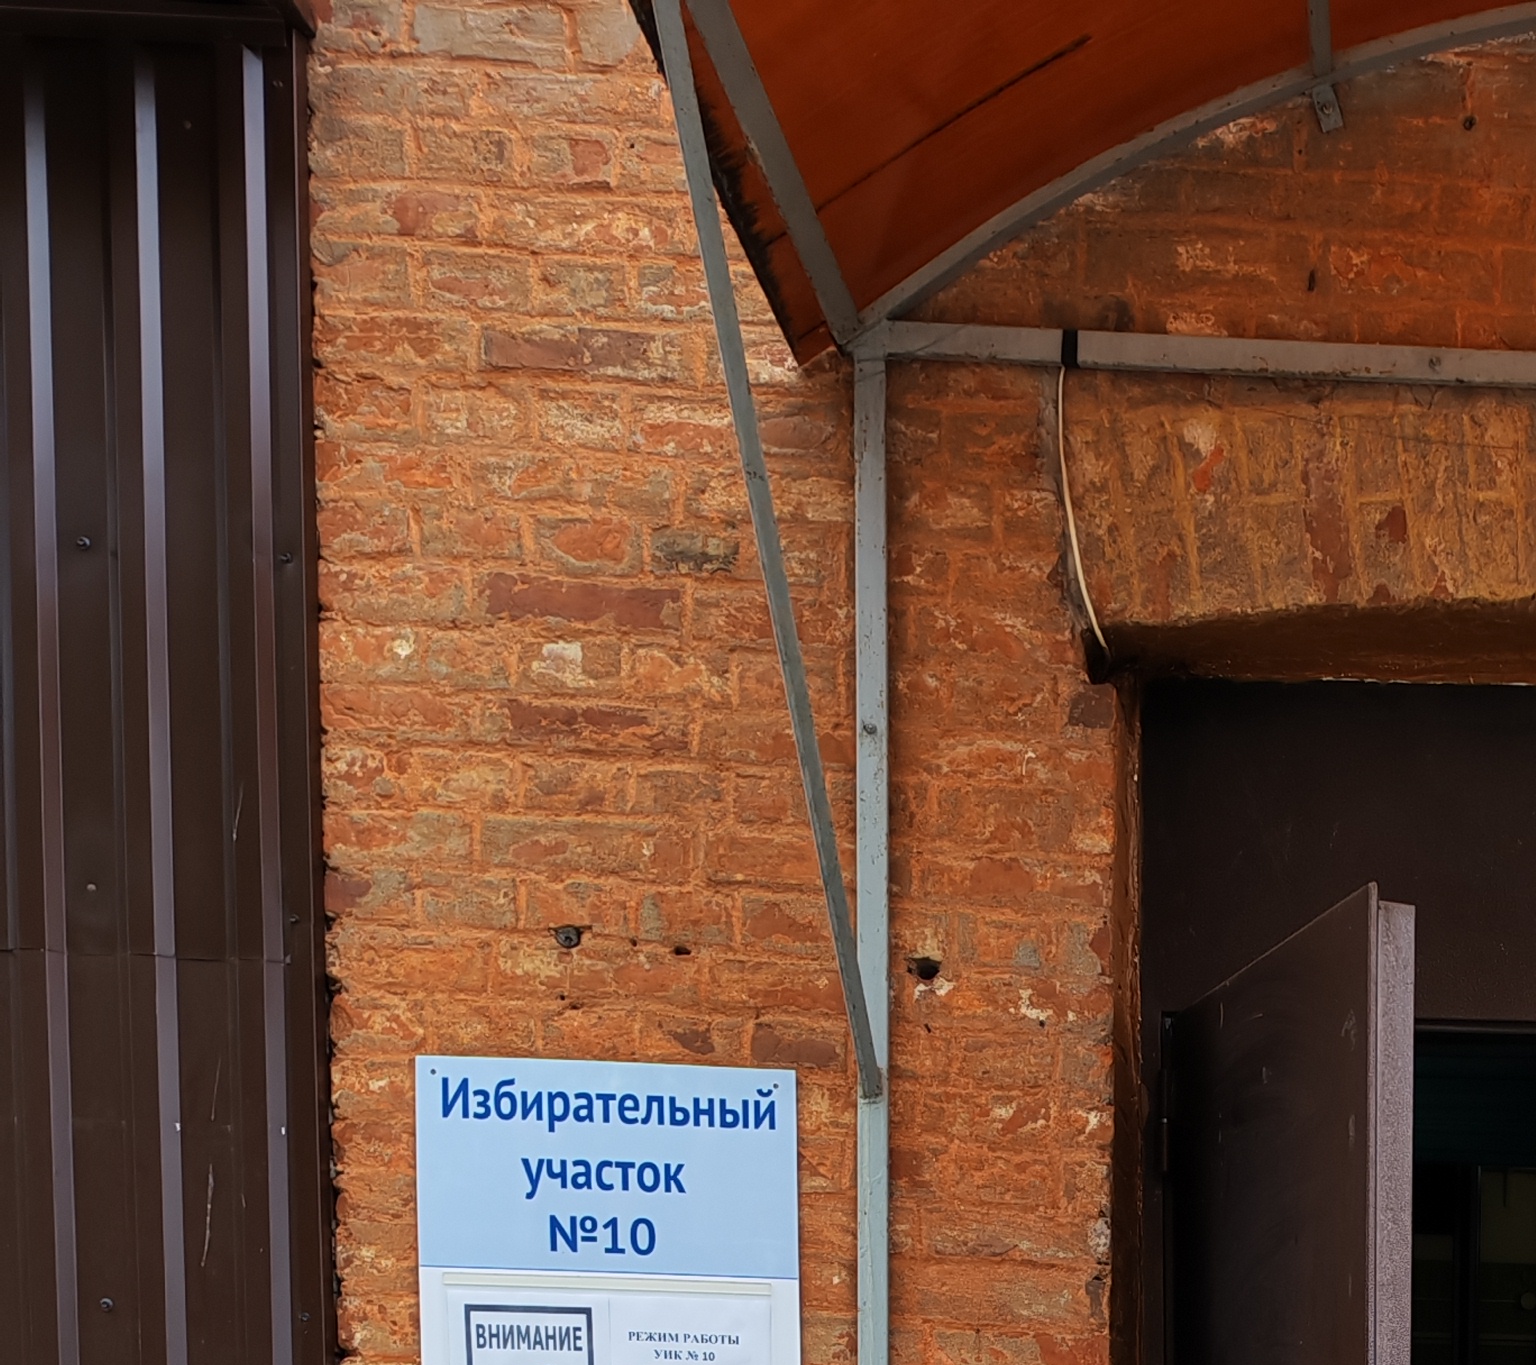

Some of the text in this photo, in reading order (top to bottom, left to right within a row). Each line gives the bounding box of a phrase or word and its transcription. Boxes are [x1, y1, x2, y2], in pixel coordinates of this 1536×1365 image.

[441, 1076, 776, 1132] Избирательный
[521, 1157, 686, 1200] участок
[549, 1214, 656, 1256] №10
[476, 1324, 583, 1351] ВНИМАНИЕ
[628, 1331, 740, 1345] РЕЖИМ РАБОТЫ
[654, 1349, 715, 1361] УИК № 10
